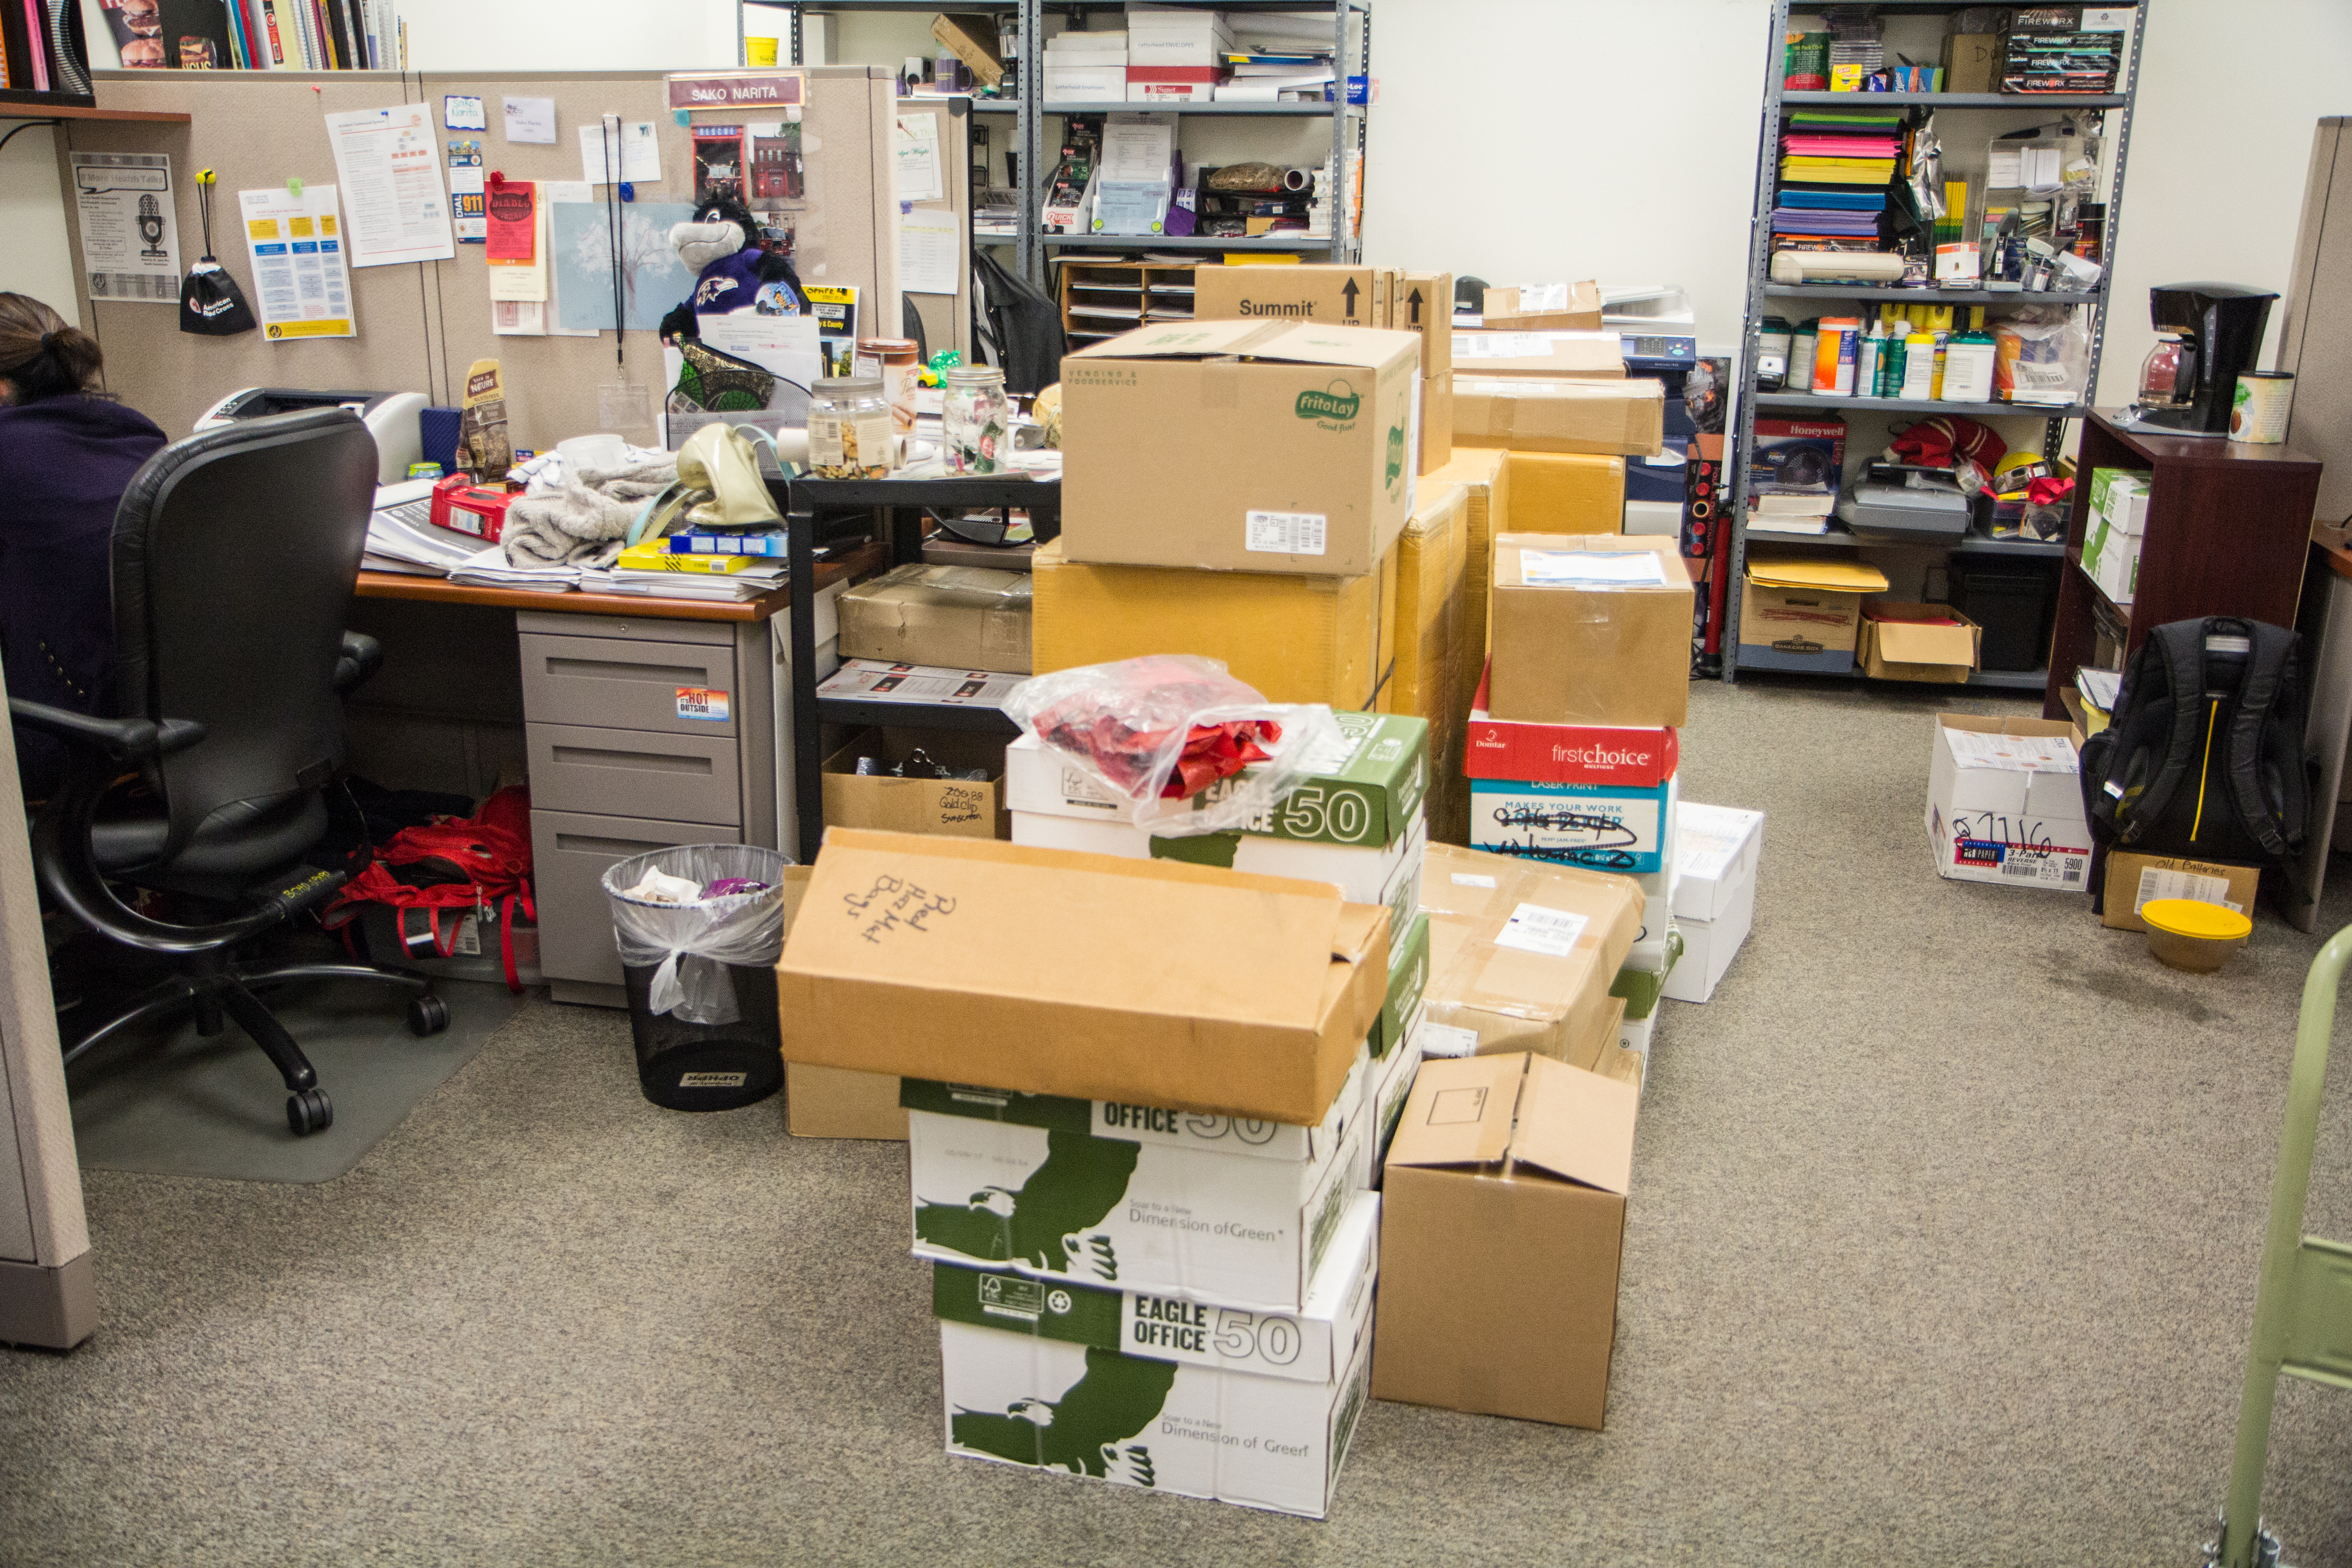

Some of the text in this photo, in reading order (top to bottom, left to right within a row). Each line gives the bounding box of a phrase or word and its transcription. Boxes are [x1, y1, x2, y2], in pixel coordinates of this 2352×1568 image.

[1895, 71, 1905, 93] Ziploc
[692, 87, 778, 101] SAKO NARITA
[452, 99, 479, 118] Sako Narita
[141, 174, 162, 183] Talks
[455, 194, 464, 217] DIAL
[463, 195, 483, 211] 911
[1047, 211, 1074, 227] QUICK
[203, 297, 231, 311] American
[216, 302, 234, 314] Cross
[1240, 299, 1313, 317] Summit
[827, 321, 844, 330] County
[470, 379, 494, 393] NATURE
[1068, 377, 1137, 387] FOODSERVICE
[1317, 420, 1338, 432] Good
[1790, 425, 1844, 437] Honeywell
[689, 692, 709, 705] HOT
[681, 704, 710, 713] OUTSIDE
[1476, 740, 1506, 749] Domtar
[1552, 743, 1648, 766] firstchoice
[1531, 781, 1598, 790] LASER PRINT
[1505, 801, 1622, 813] MAKES YOUR WORK
[1283, 786, 1370, 843] 50
[1978, 849, 1997, 860] PAPER
[2065, 858, 2083, 871] 5900
[2155, 859, 2226, 876] Old Batteries
[843, 874, 903, 919] Bags
[903, 897, 956, 932] Red
[1104, 1101, 1179, 1133] OFFICE
[1129, 1198, 1149, 1211] Soar
[1129, 1208, 1276, 1242] Dimension of Green
[1135, 1295, 1208, 1328] EAGLE
[1134, 1320, 1207, 1353] OFFICE
[1213, 1308, 1302, 1365] 50
[1162, 1412, 1182, 1426] Soar
[1161, 1421, 1239, 1447] Dimension
[1243, 1436, 1259, 1449] of
